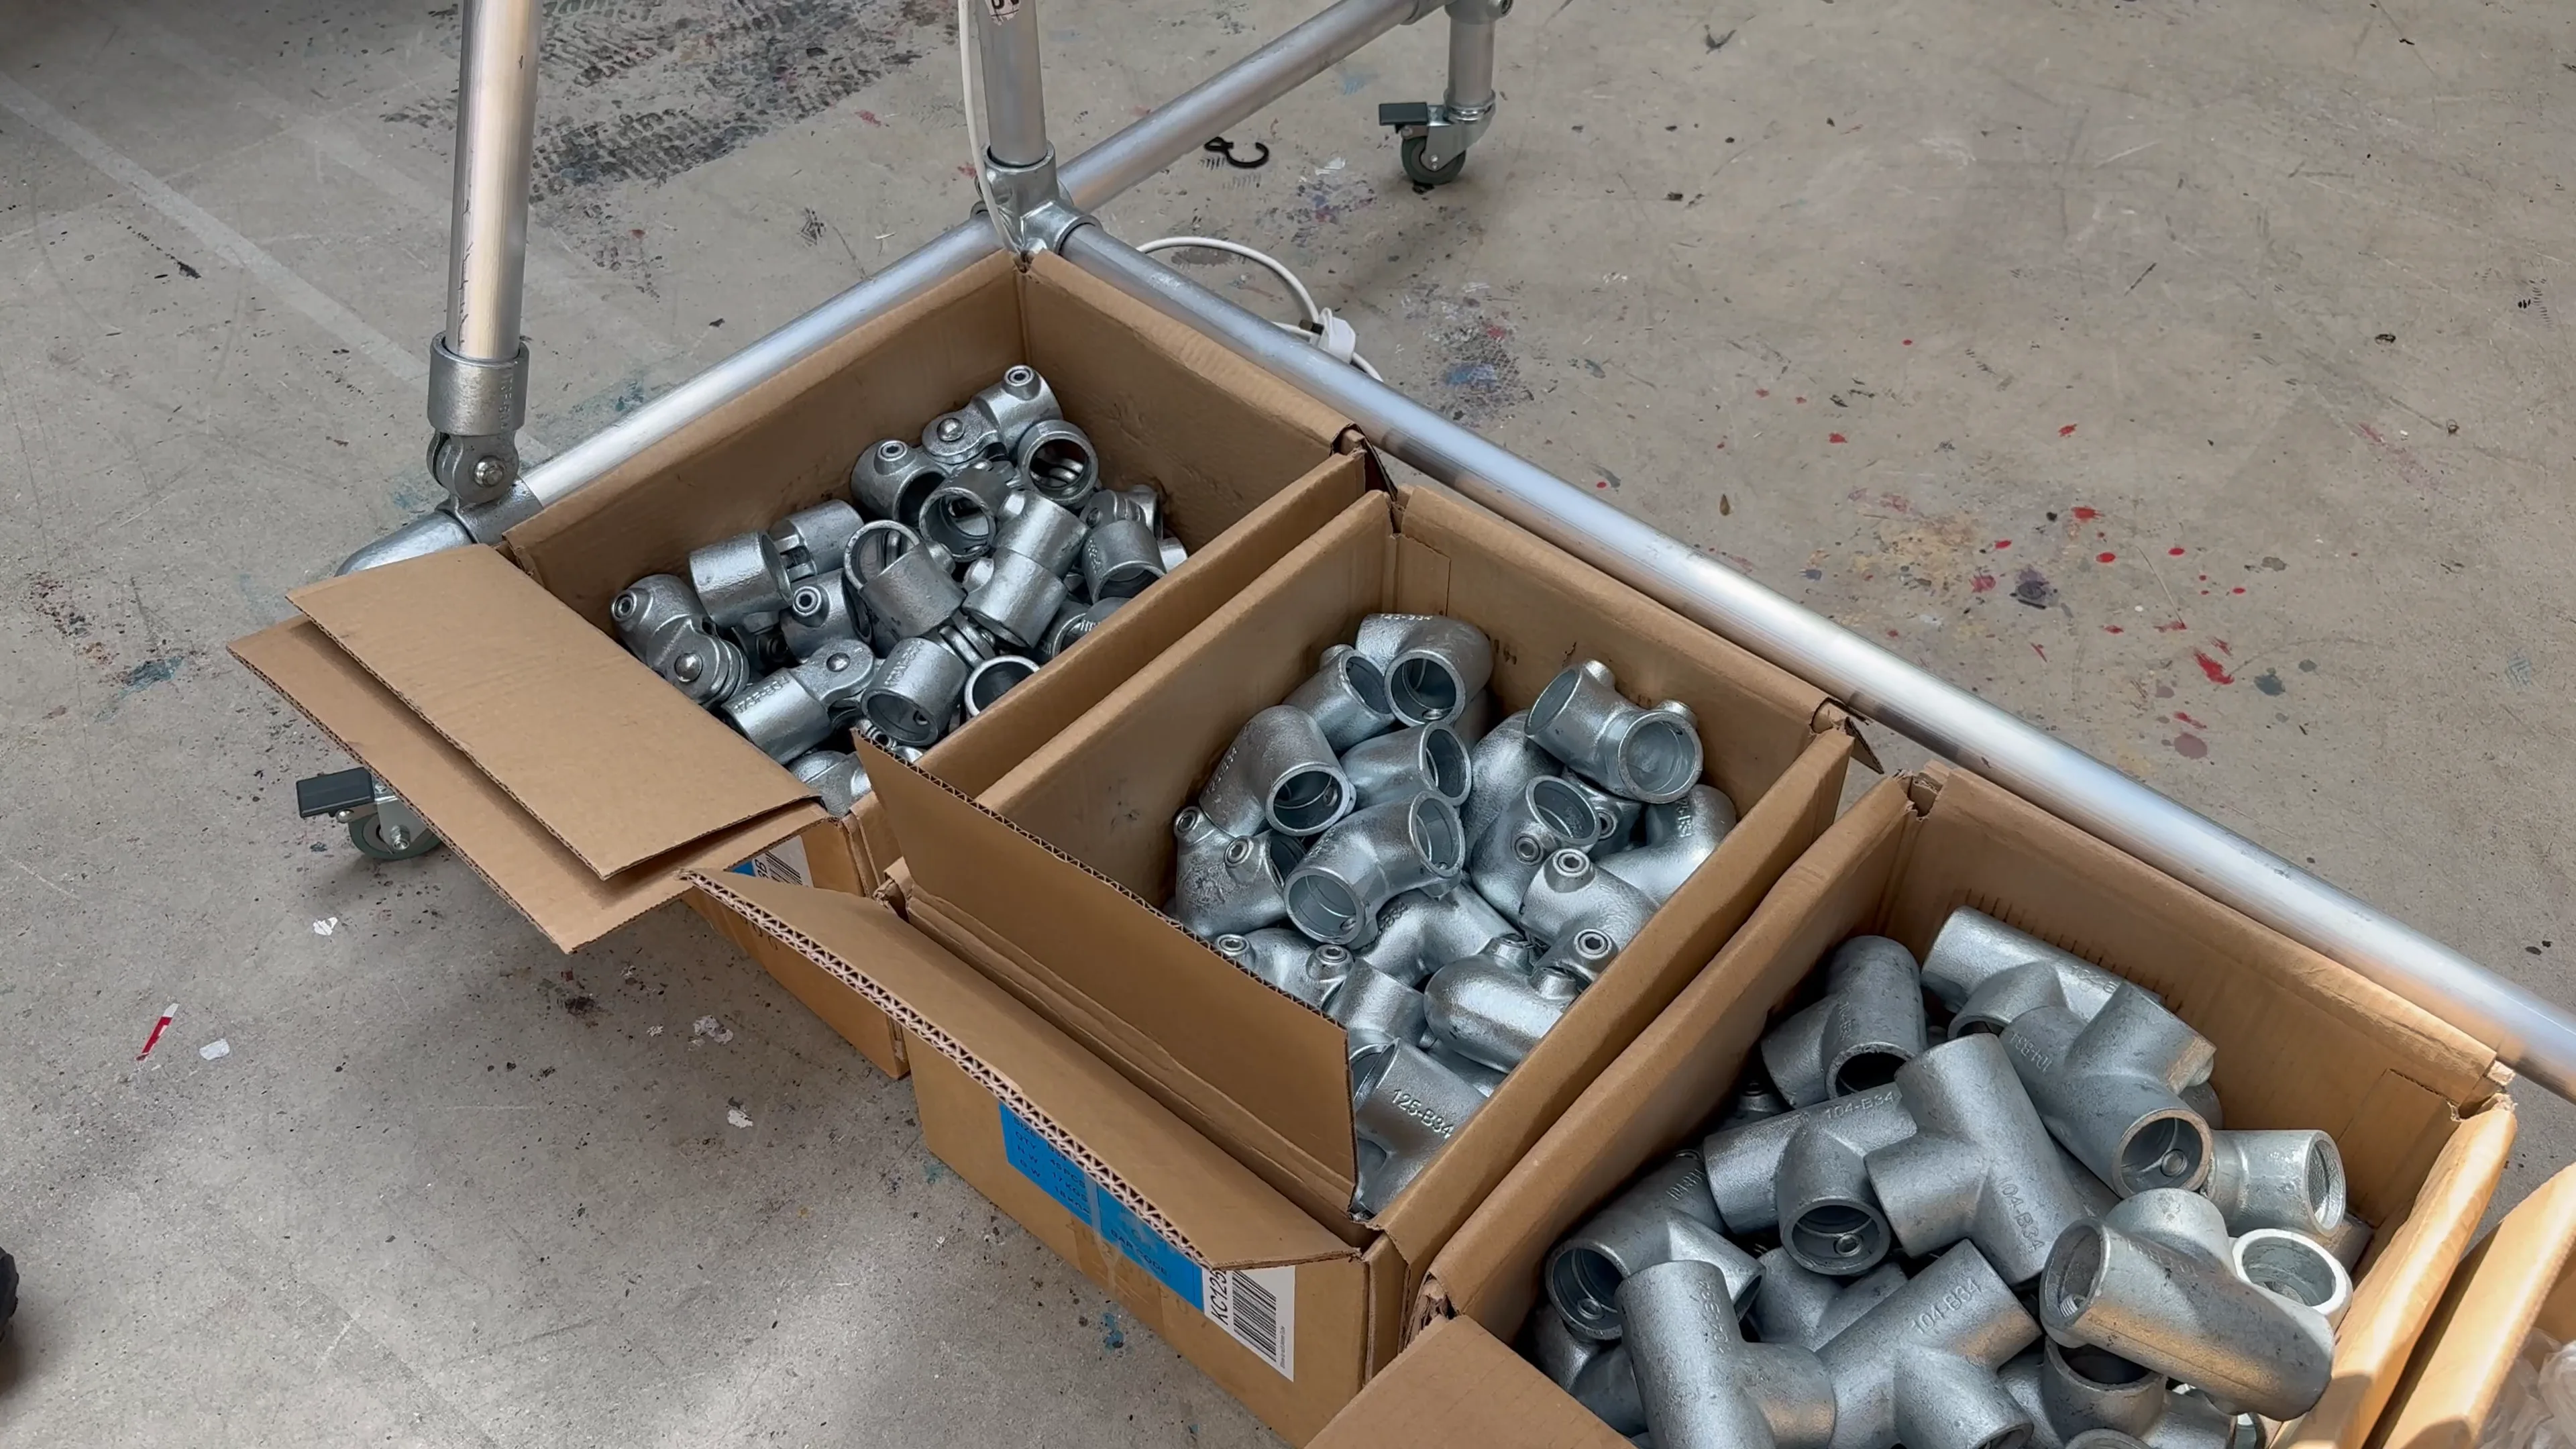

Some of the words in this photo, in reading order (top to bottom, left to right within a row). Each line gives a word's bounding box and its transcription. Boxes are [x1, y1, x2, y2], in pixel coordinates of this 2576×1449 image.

[1392, 1088, 1454, 1138] 125-B34
[1825, 1091, 1894, 1119] 104-B34
[1015, 1131, 1036, 1149] QTY
[1996, 1177, 2045, 1252] 104-B34
[1210, 1269, 1229, 1326] KC125
[1912, 1277, 1983, 1335] 104-B34
